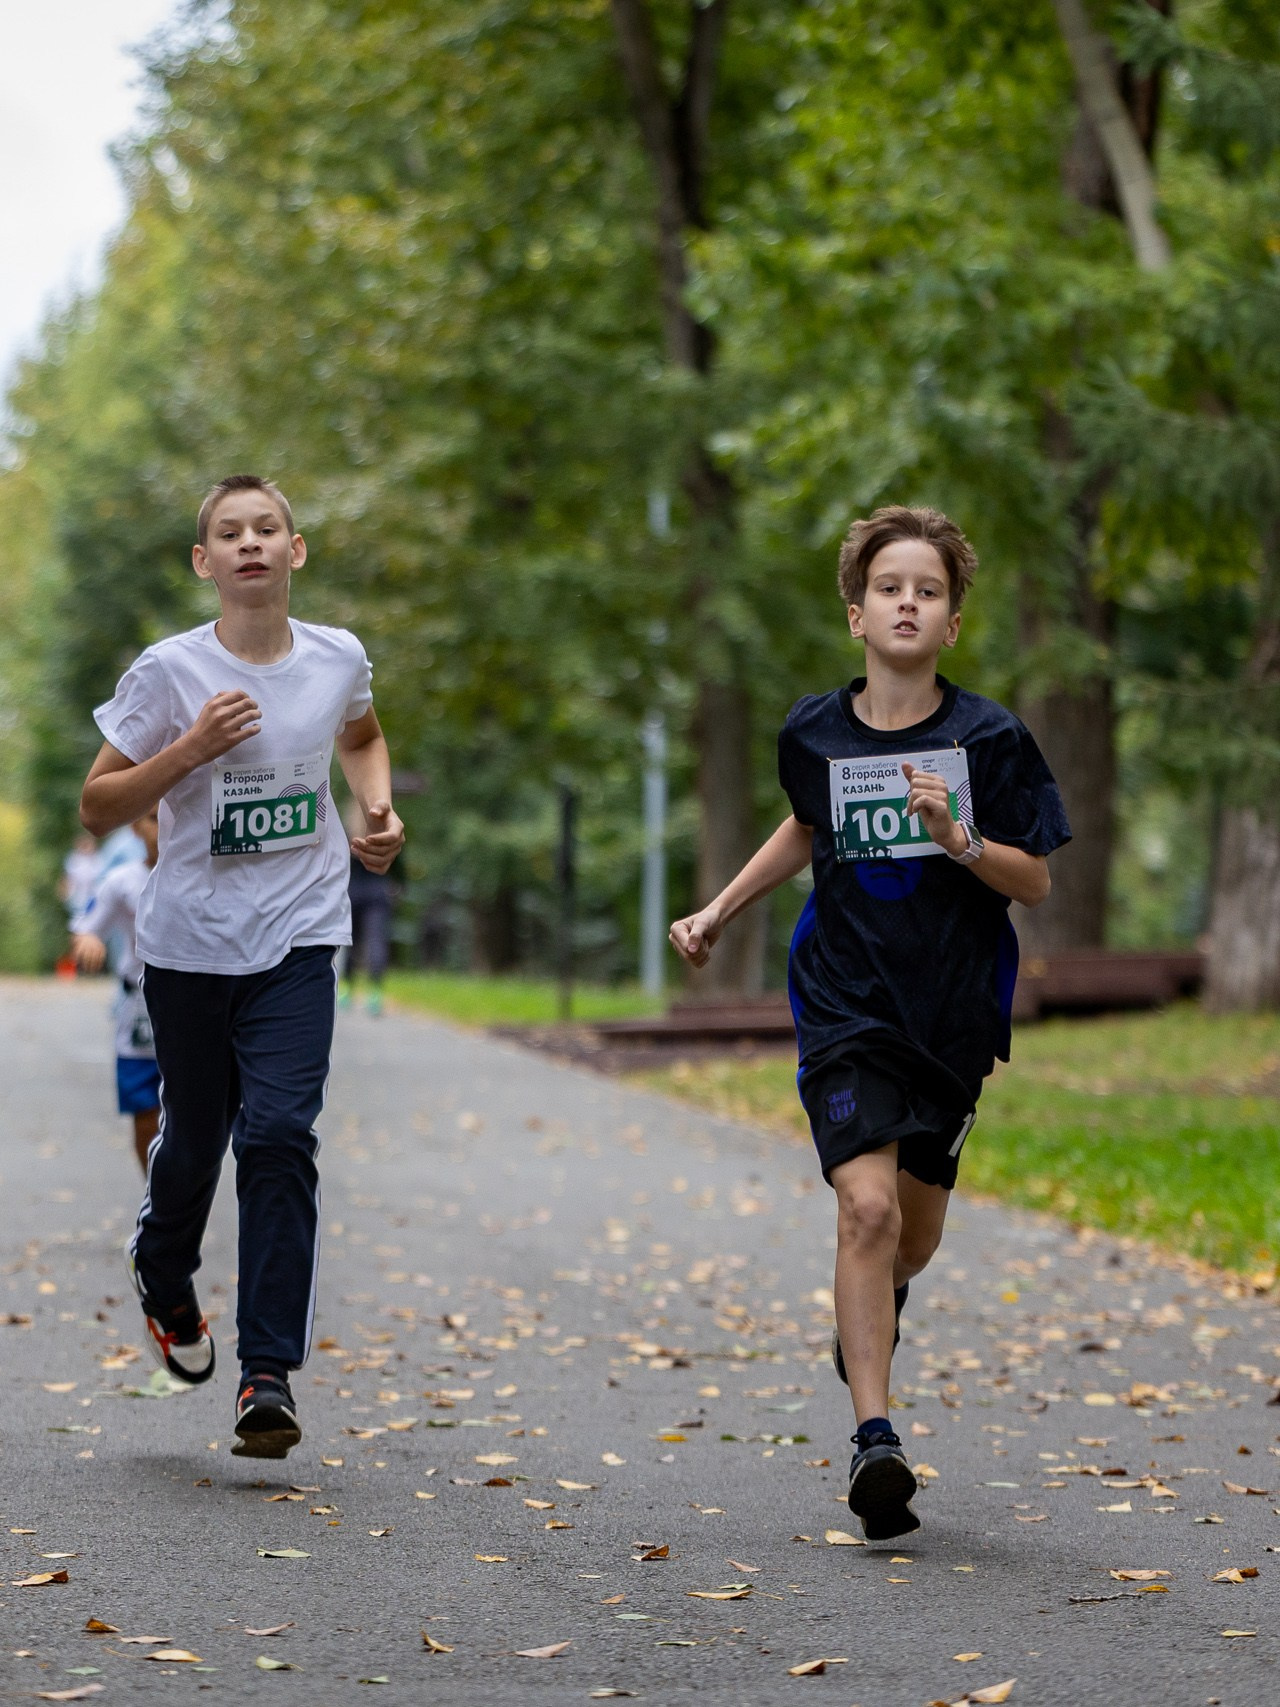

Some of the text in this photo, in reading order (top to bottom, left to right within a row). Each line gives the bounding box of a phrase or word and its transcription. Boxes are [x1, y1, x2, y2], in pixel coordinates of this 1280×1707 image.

[871, 761, 898, 769] забегов
[224, 772, 276, 784] 8 городов
[842, 767, 898, 781] 8 городов
[224, 786, 263, 797] КАЗАНЬ
[843, 783, 885, 794] КАЗАНЬ
[230, 800, 308, 838] 1081
[852, 807, 920, 842] 101
